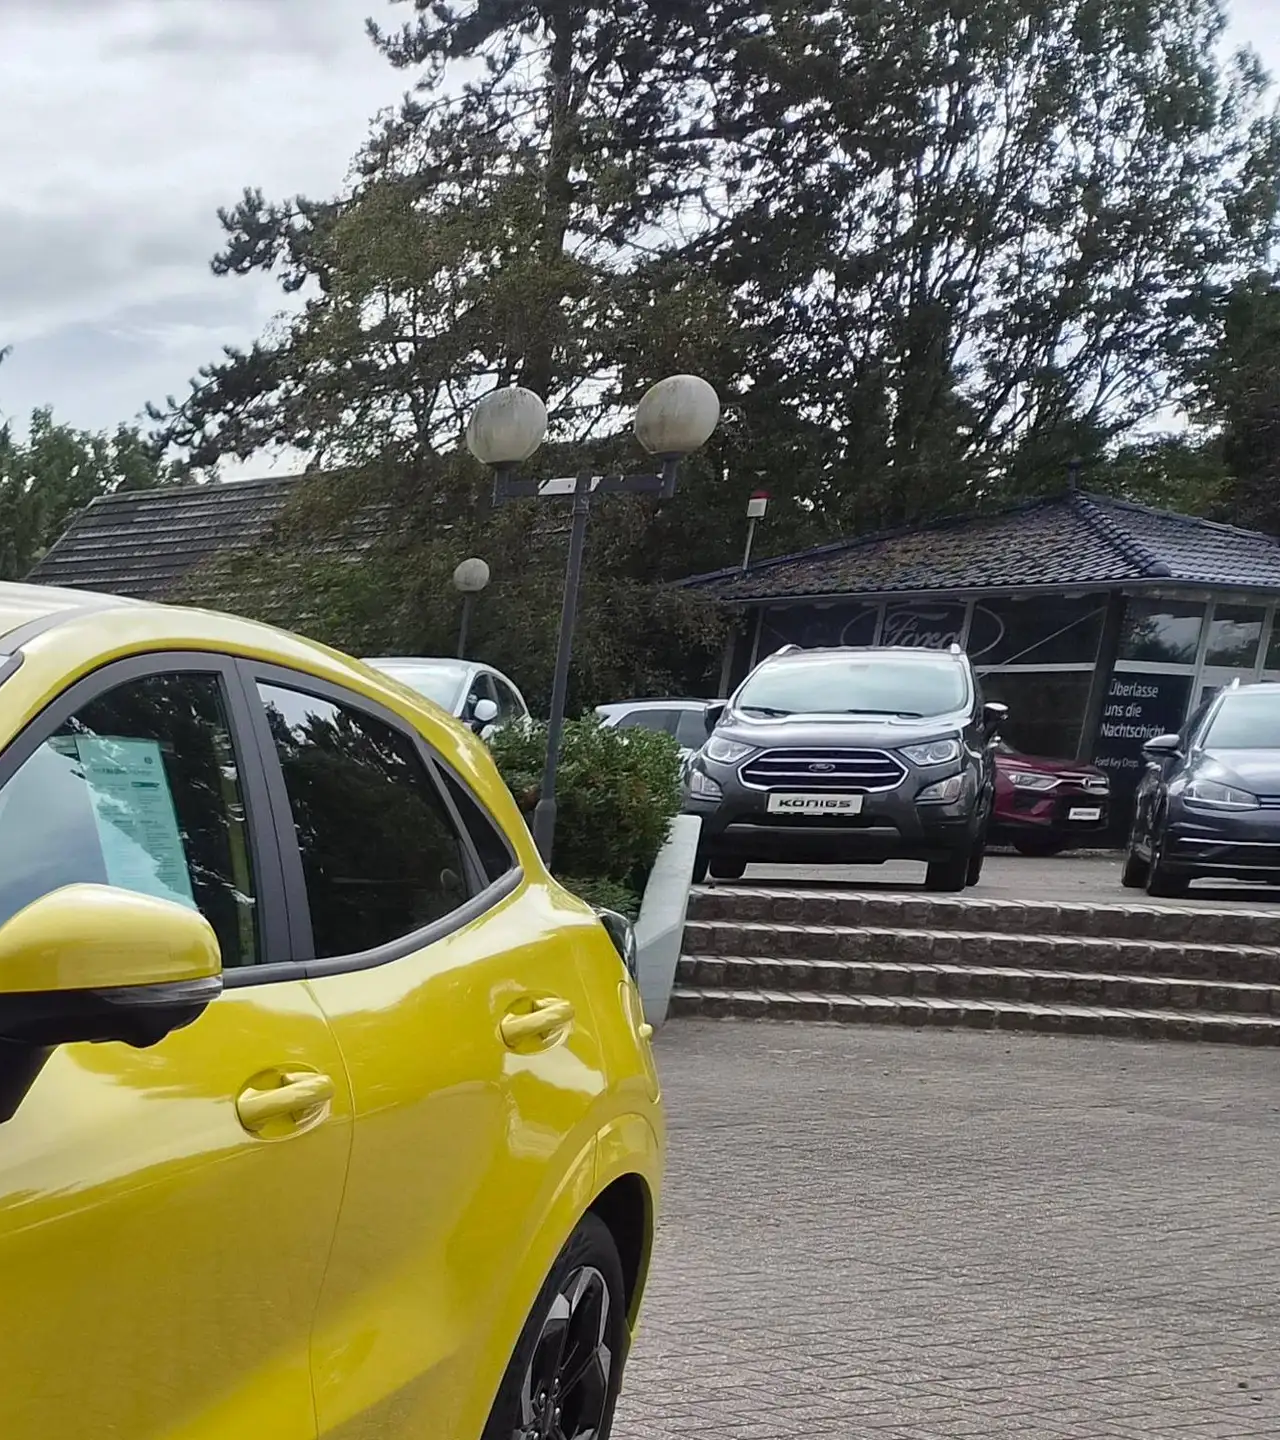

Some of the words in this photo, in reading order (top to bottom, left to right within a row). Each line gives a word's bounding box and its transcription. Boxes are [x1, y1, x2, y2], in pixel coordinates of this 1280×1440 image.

[1109, 678, 1159, 698] Überlasse
[1104, 703, 1123, 717] uns
[1125, 702, 1142, 718] die
[1100, 721, 1165, 739] Nachtschicht
[778, 797, 851, 808] KÖNIGS
